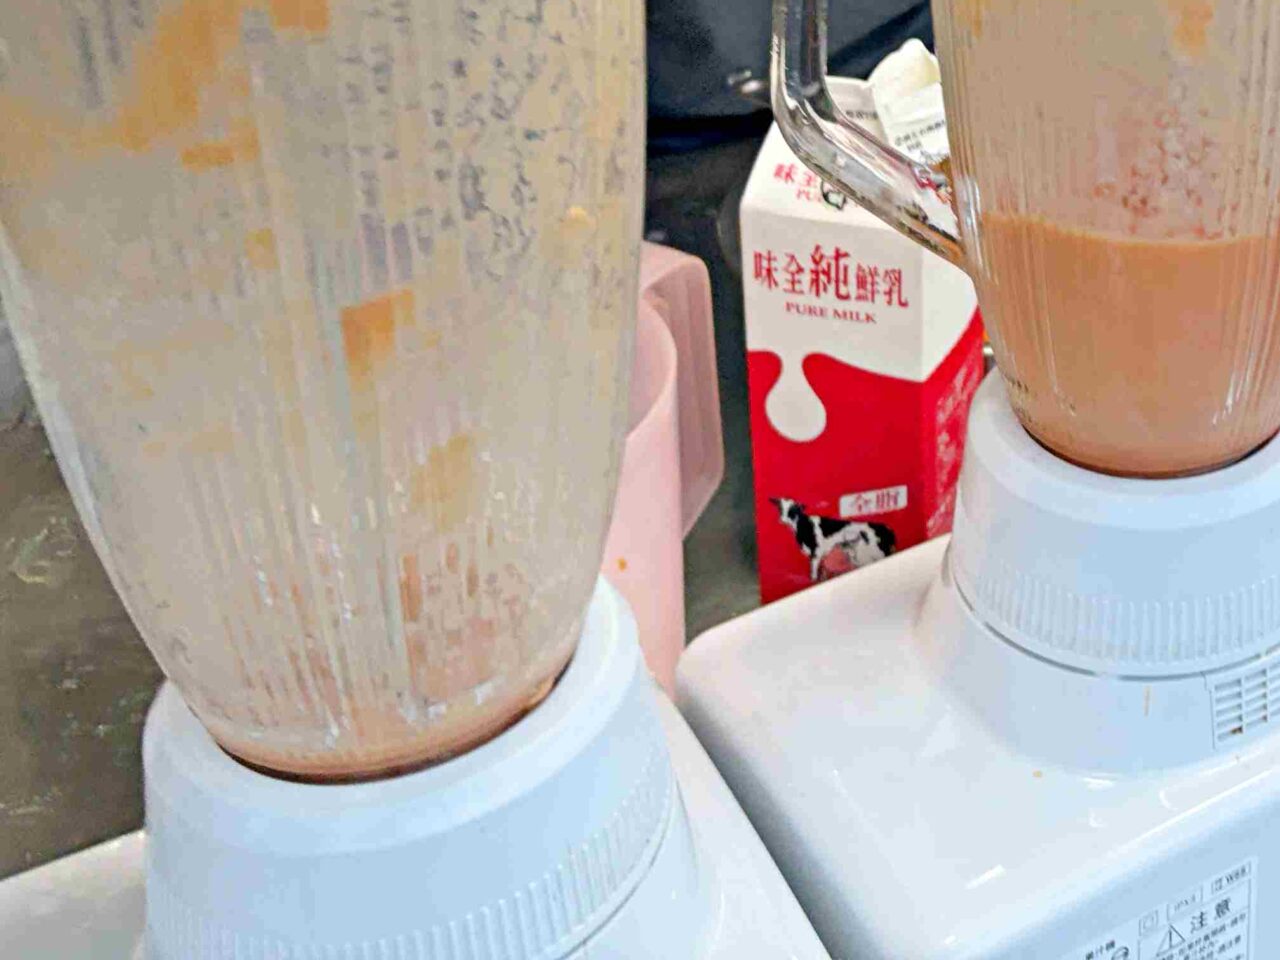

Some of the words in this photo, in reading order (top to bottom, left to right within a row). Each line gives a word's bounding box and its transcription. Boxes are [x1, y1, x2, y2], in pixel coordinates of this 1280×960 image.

[753, 245, 909, 308] 味全純鮮乳
[785, 301, 828, 319] PURE
[833, 308, 878, 324] MILK
[1190, 897, 1231, 933] 注意
